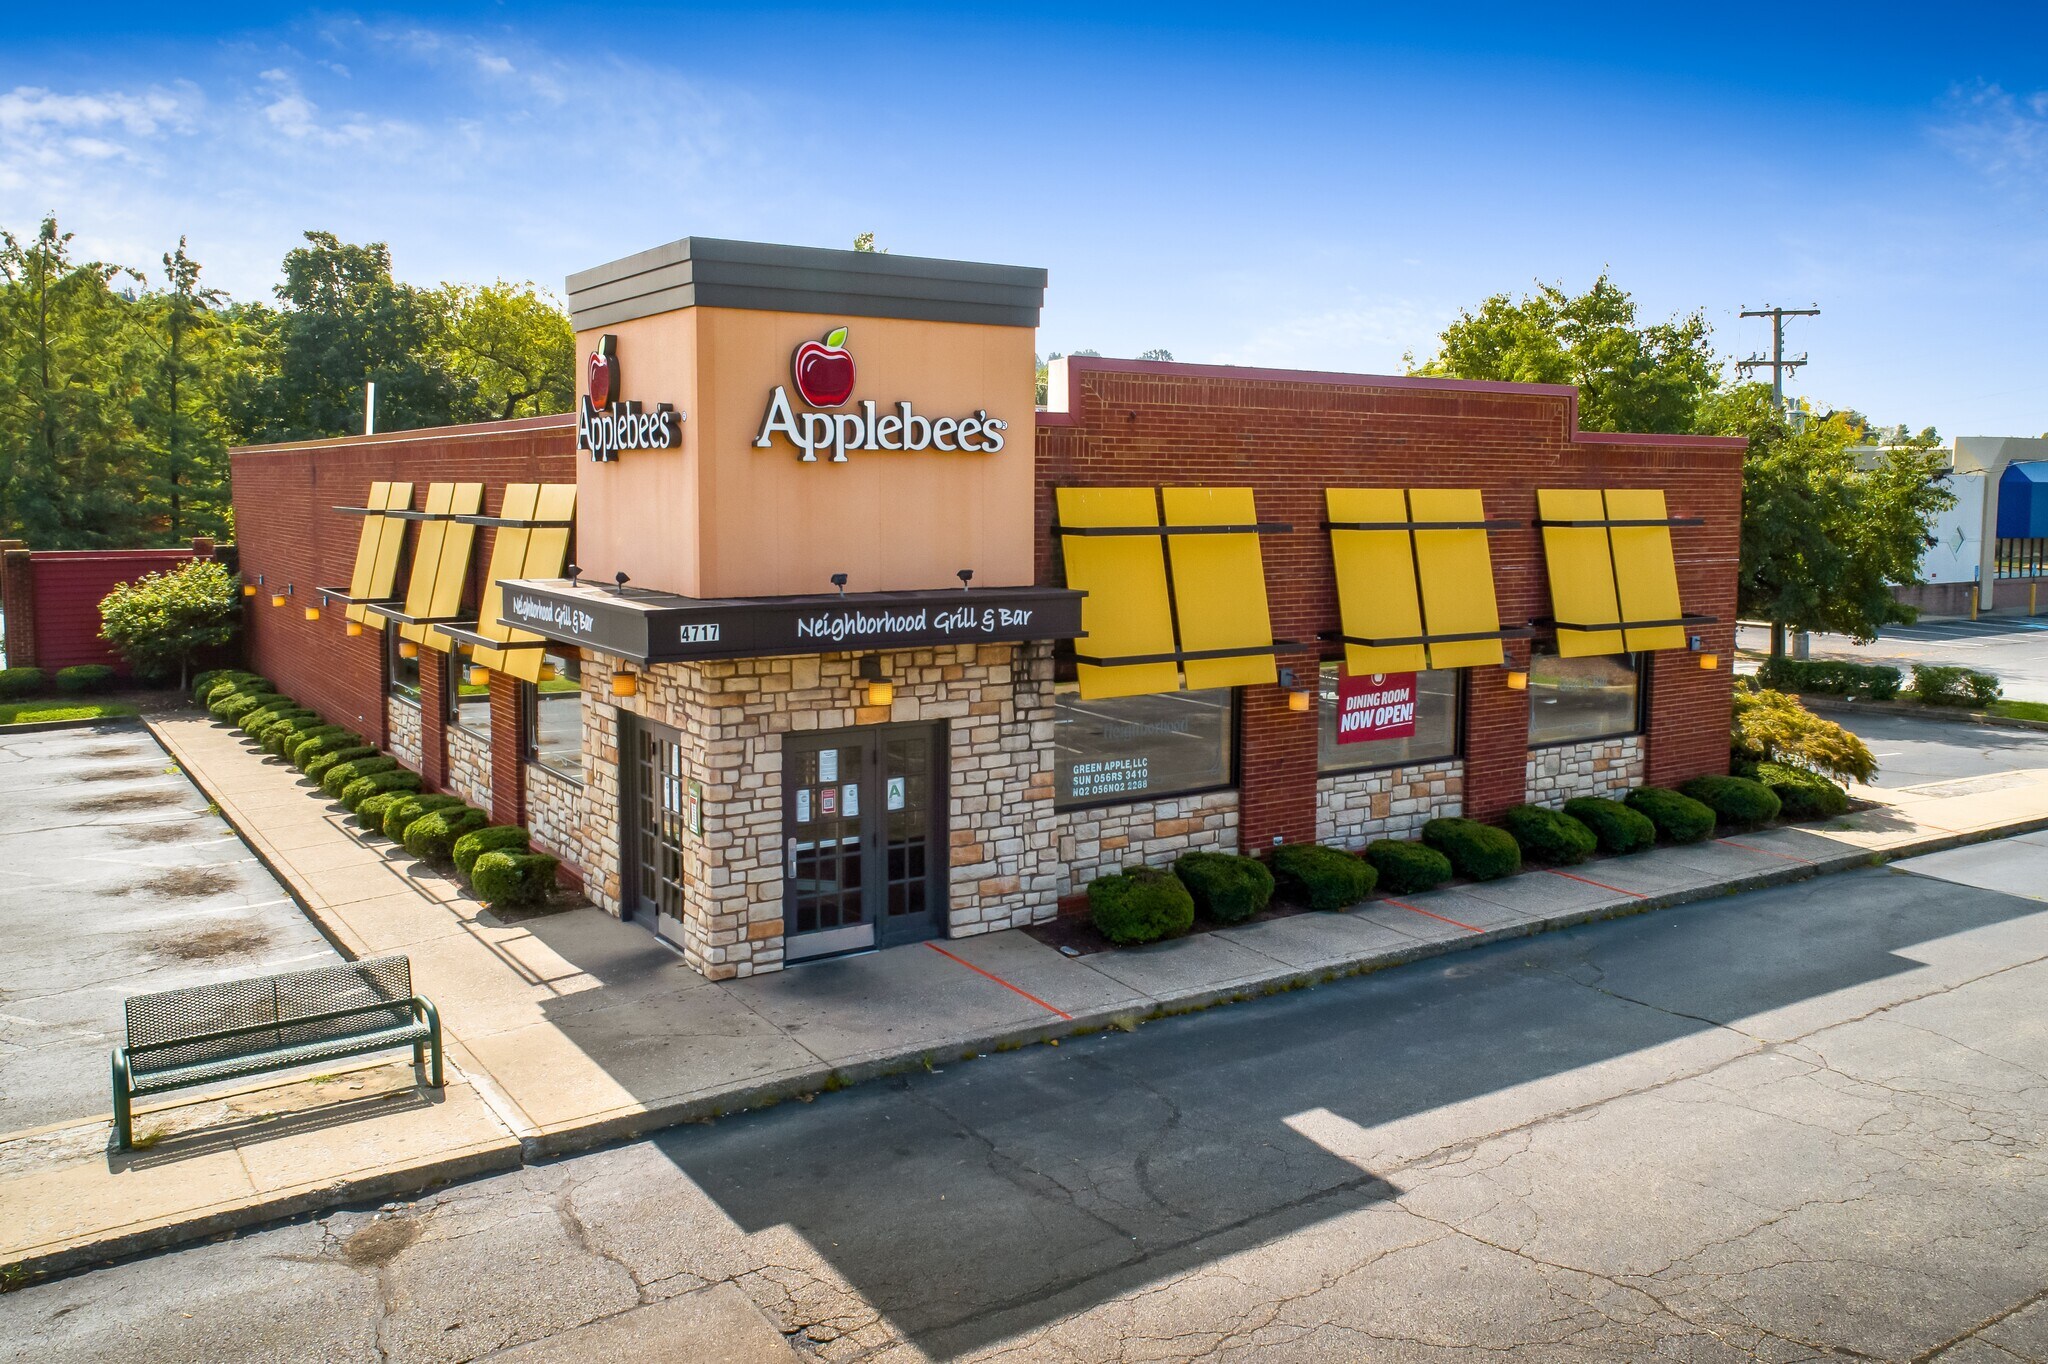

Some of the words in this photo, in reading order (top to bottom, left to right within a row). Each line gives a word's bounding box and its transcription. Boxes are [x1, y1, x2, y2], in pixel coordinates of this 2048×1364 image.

[577, 395, 671, 462] Applebee's
[755, 385, 1006, 462] Applebee's
[513, 594, 554, 621] Neighborhood
[554, 605, 572, 629] Grill
[579, 610, 594, 632] Bar
[797, 608, 927, 641] Neighborhood
[933, 607, 978, 634] Grill
[981, 609, 995, 632] &
[999, 608, 1033, 626] Bar
[681, 625, 718, 642] 4717
[1346, 691, 1380, 711] DINING
[1381, 687, 1410, 705] ROOM
[1341, 708, 1376, 733] NOW
[1375, 702, 1414, 726] OPEN!
[1073, 762, 1102, 775] GREEN
[1133, 757, 1148, 768] LLC
[1073, 774, 1092, 786] SUN
[1125, 769, 1148, 780] 3410
[889, 784, 901, 799] A
[1072, 786, 1090, 797] NQ2
